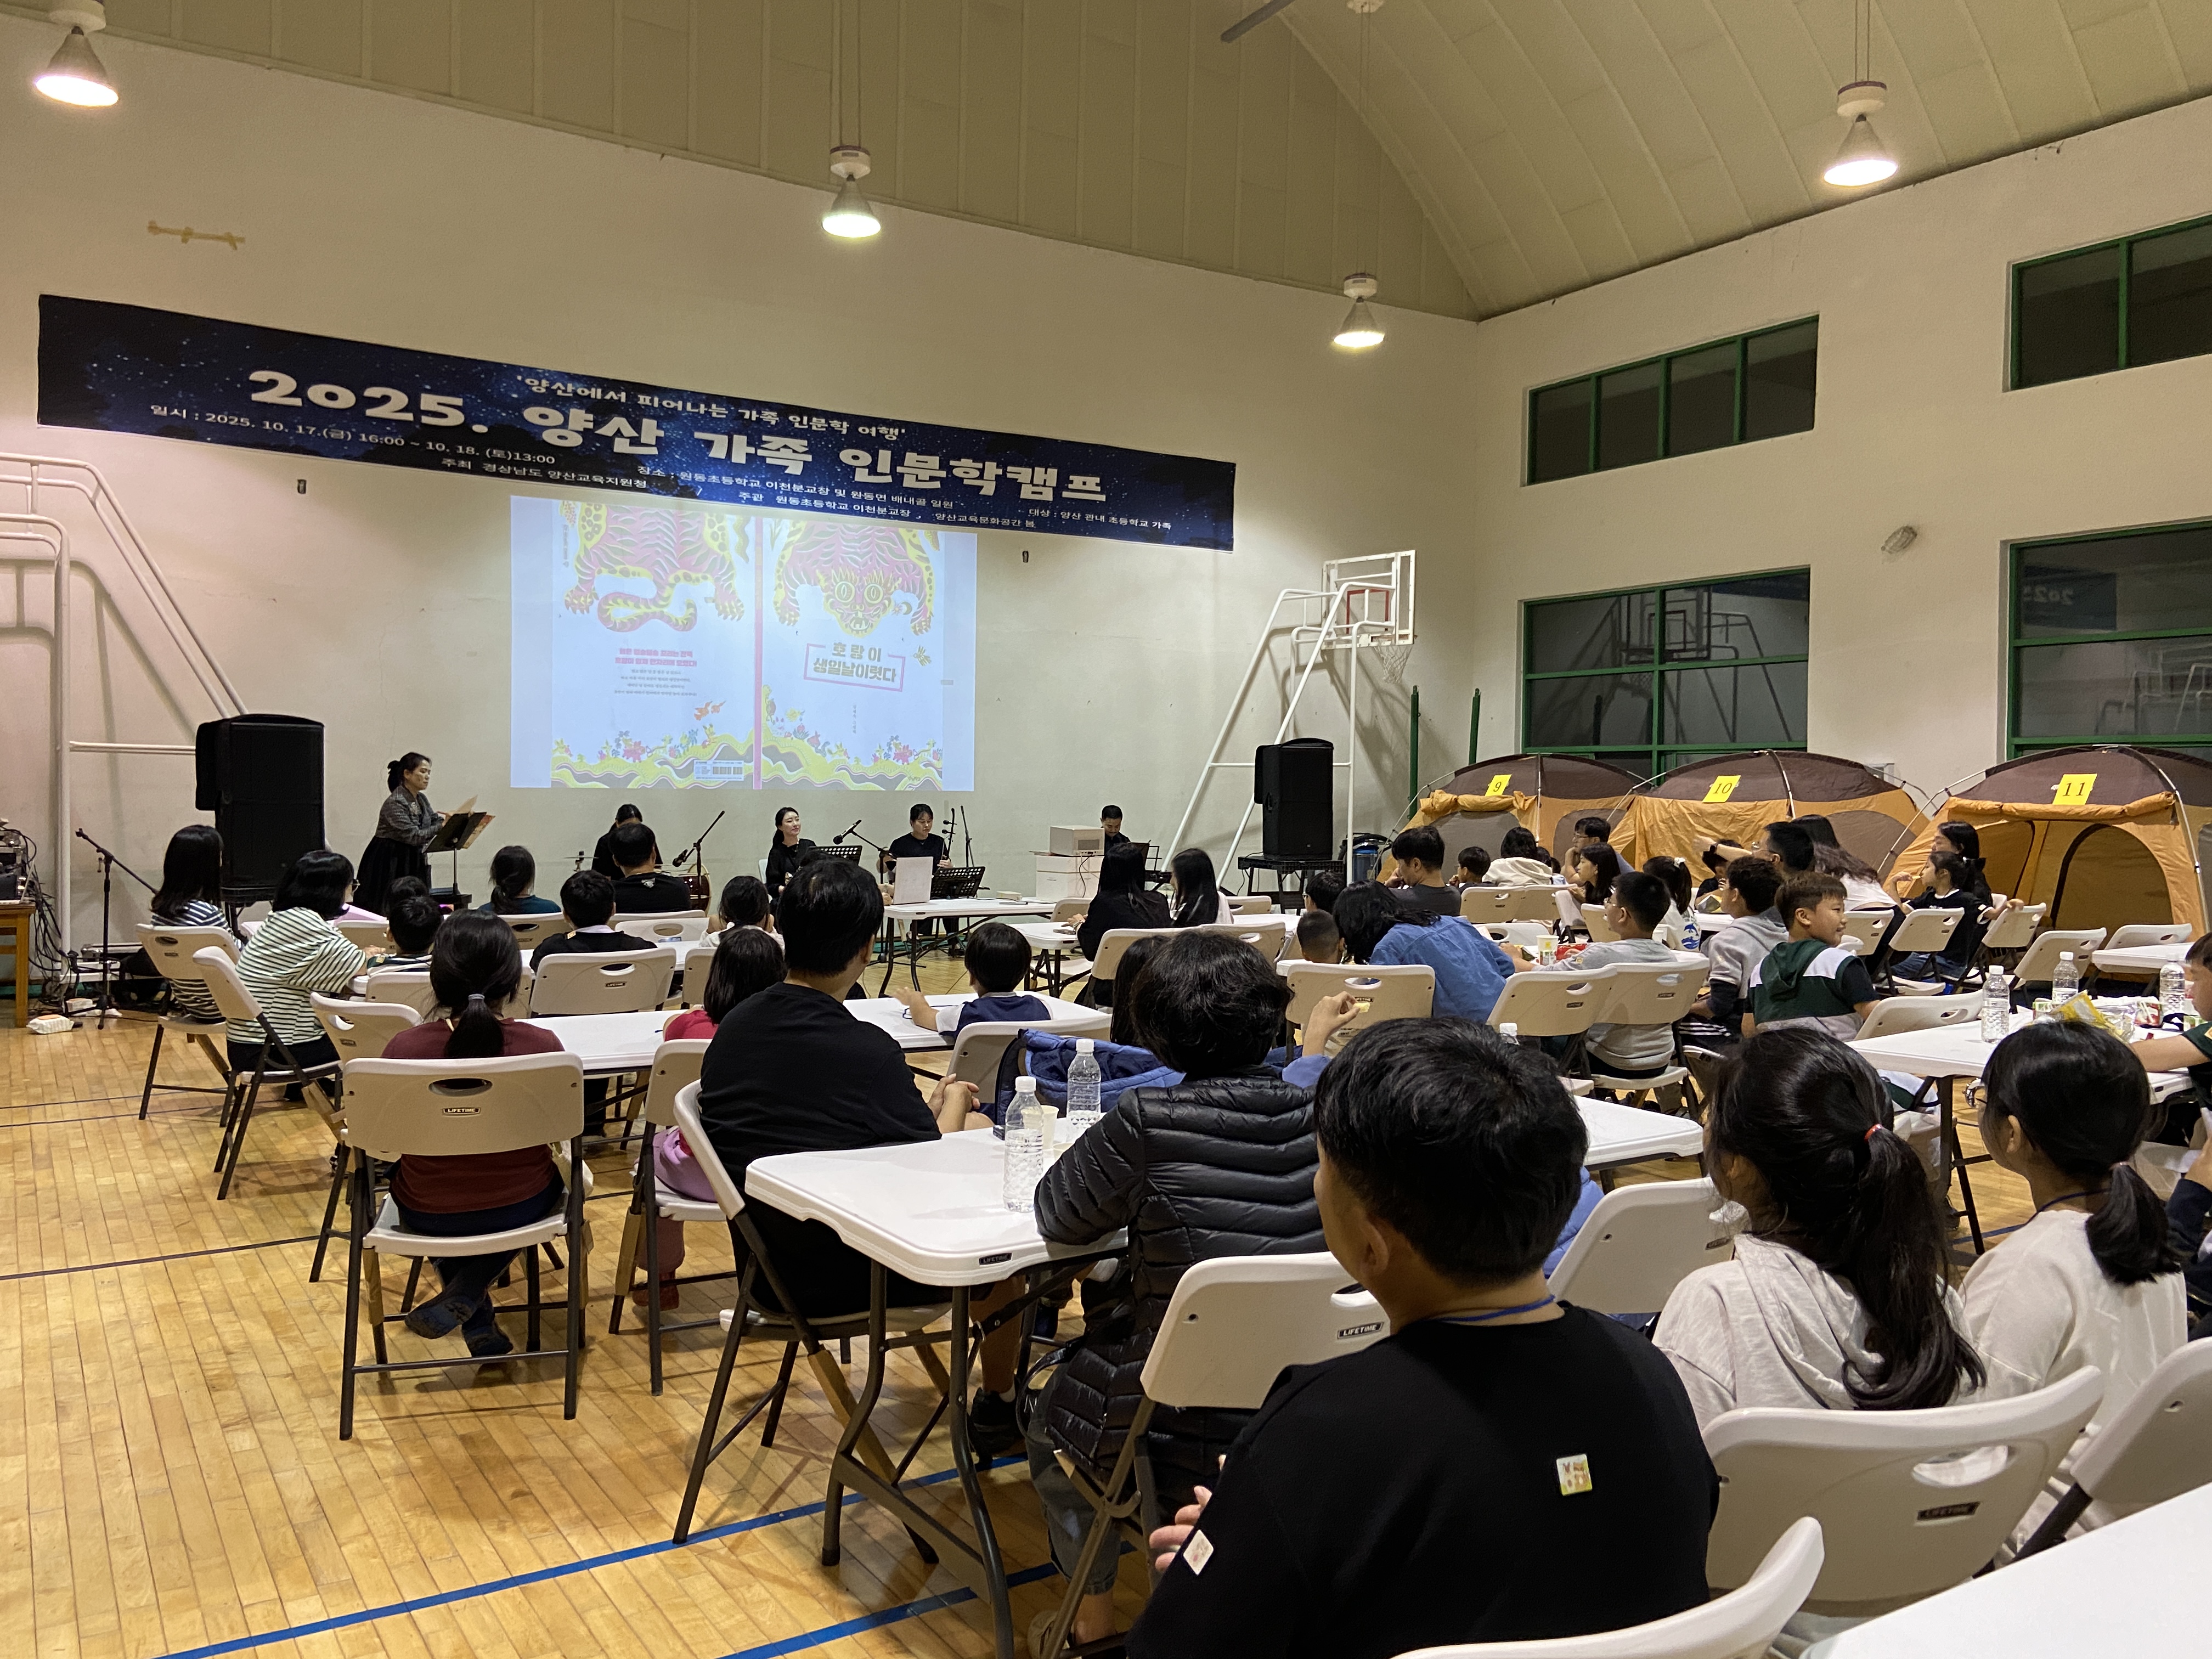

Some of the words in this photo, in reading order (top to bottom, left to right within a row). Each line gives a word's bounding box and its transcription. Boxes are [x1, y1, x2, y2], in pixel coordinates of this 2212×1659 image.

[637, 394, 728, 418] 피어나는
[738, 409, 779, 425] 가족
[788, 415, 849, 434] 인문학
[858, 426, 906, 441] 여행'
[151, 405, 186, 419] 일시
[206, 413, 255, 428] 2025.
[262, 420, 289, 432] 10.
[360, 433, 405, 446] 16:00
[426, 442, 449, 452] 10.
[456, 445, 479, 455] 18.
[249, 370, 488, 433] 2025.
[523, 407, 664, 455] 양산
[694, 432, 812, 475] 가족
[839, 449, 1106, 501] 인문학캠프
[442, 458, 471, 470] 주최
[483, 462, 543, 477] 경상남도
[548, 470, 647, 489] 양산교육지원청
[738, 492, 764, 502] 주관
[776, 495, 849, 510] 원동초등학교
[853, 504, 911, 517] 이천분교장
[935, 513, 1021, 527] 양산교육문화공간
[638, 466, 665, 477] 장소
[680, 471, 760, 488] 원동초등학교
[766, 481, 830, 496] 이천분교장
[834, 488, 846, 498] 및
[851, 491, 887, 502] 원동면
[891, 495, 926, 506] 배내골
[931, 500, 953, 509] 일원
[1029, 509, 1050, 517] 대상
[1060, 511, 1081, 521] 양산
[1085, 514, 1105, 523] 관내
[1108, 517, 1148, 528] 초등학교
[1152, 521, 1171, 530] 가족
[814, 658, 896, 682] 생일날이렷다
[1493, 781, 1502, 792] 9
[1713, 783, 1732, 794] 10
[2063, 782, 2085, 796] 11
[1343, 1324, 1377, 1336] LIFETIME
